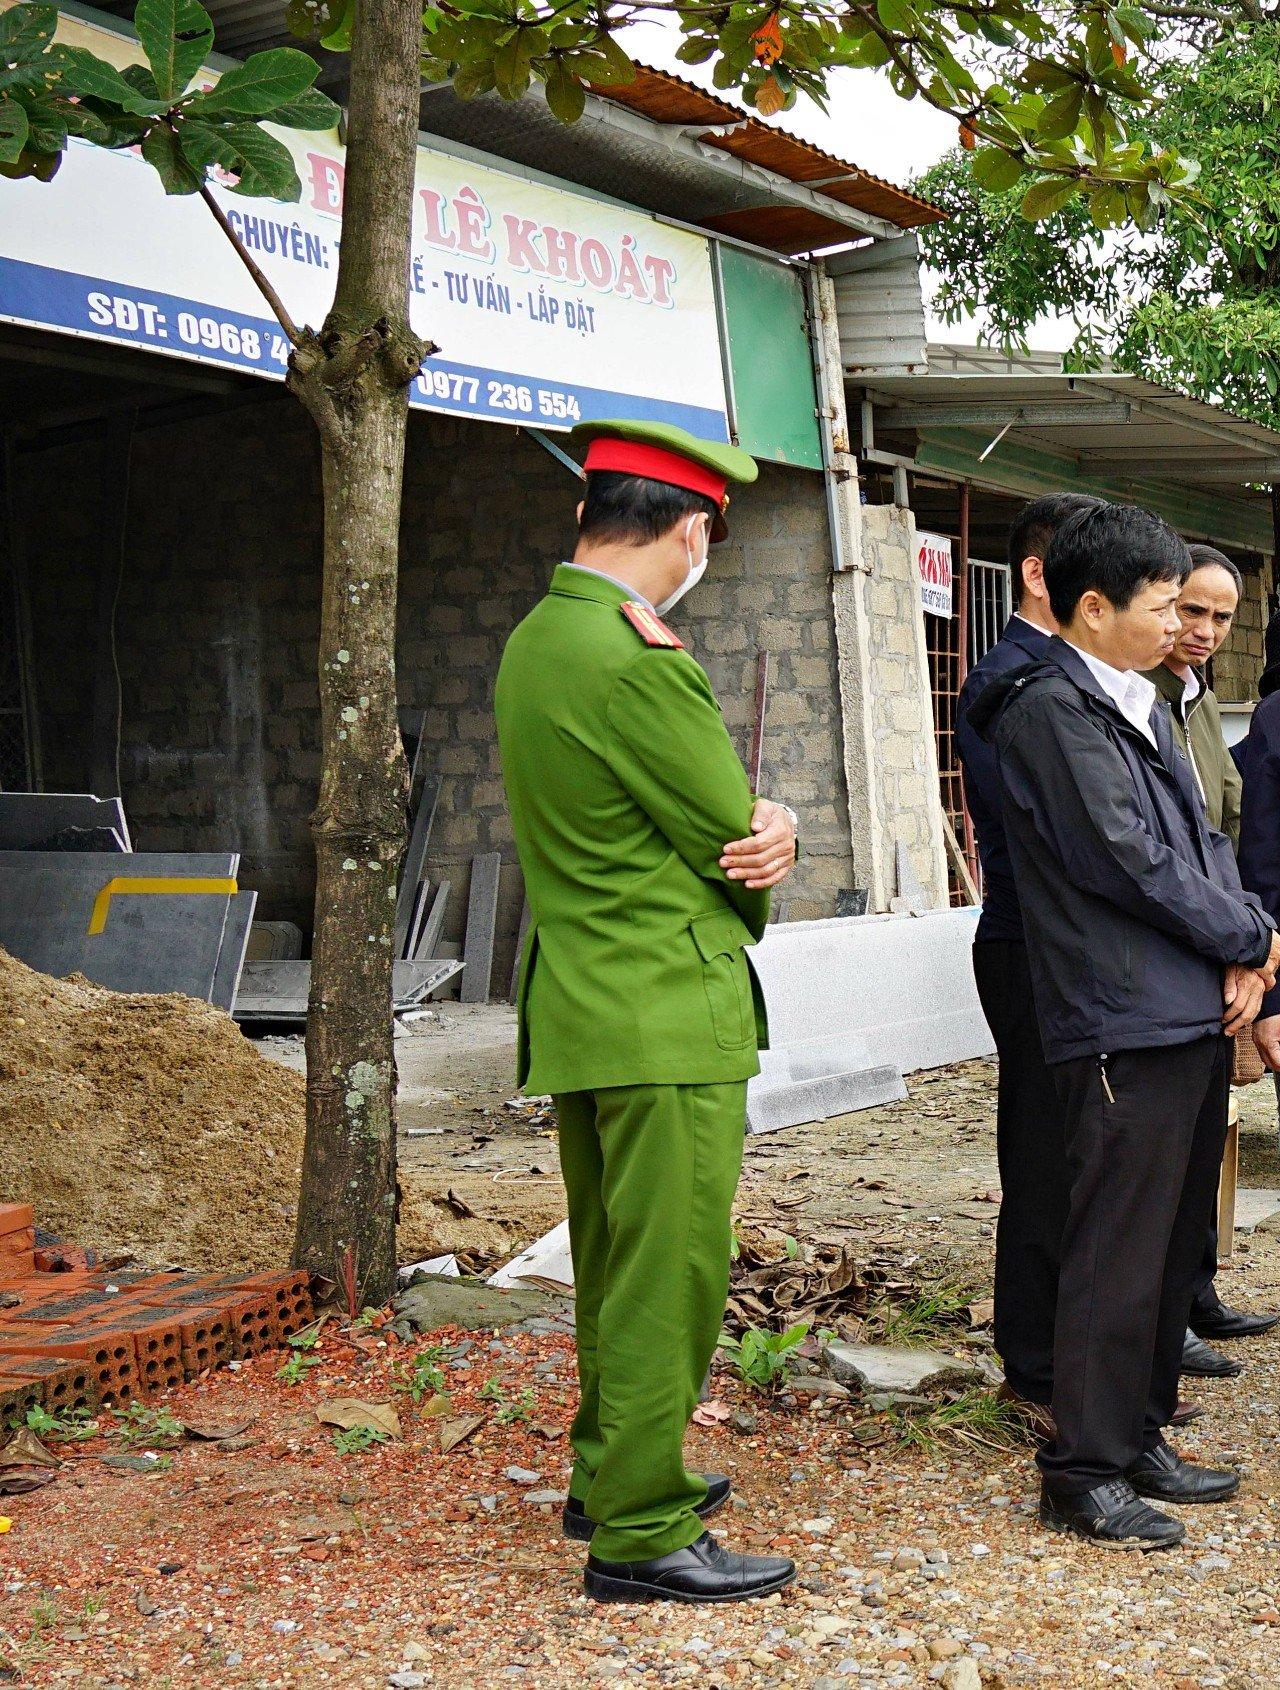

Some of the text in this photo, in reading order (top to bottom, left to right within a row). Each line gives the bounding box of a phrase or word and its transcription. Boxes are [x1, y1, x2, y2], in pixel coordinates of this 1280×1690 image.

[226, 209, 330, 270] CHUYÊN:
[443, 270, 469, 304] TƯ
[473, 272, 511, 315] VẤN
[527, 284, 560, 326] LẮP
[565, 298, 596, 337] ĐẶT
[418, 185, 493, 260] LÊ
[502, 214, 675, 306] KHOÁT
[87, 291, 169, 338] SĐT:
[178, 312, 262, 360] 0968
[417, 368, 481, 404] 0977
[487, 380, 533, 412] 236
[538, 390, 581, 421] 554
